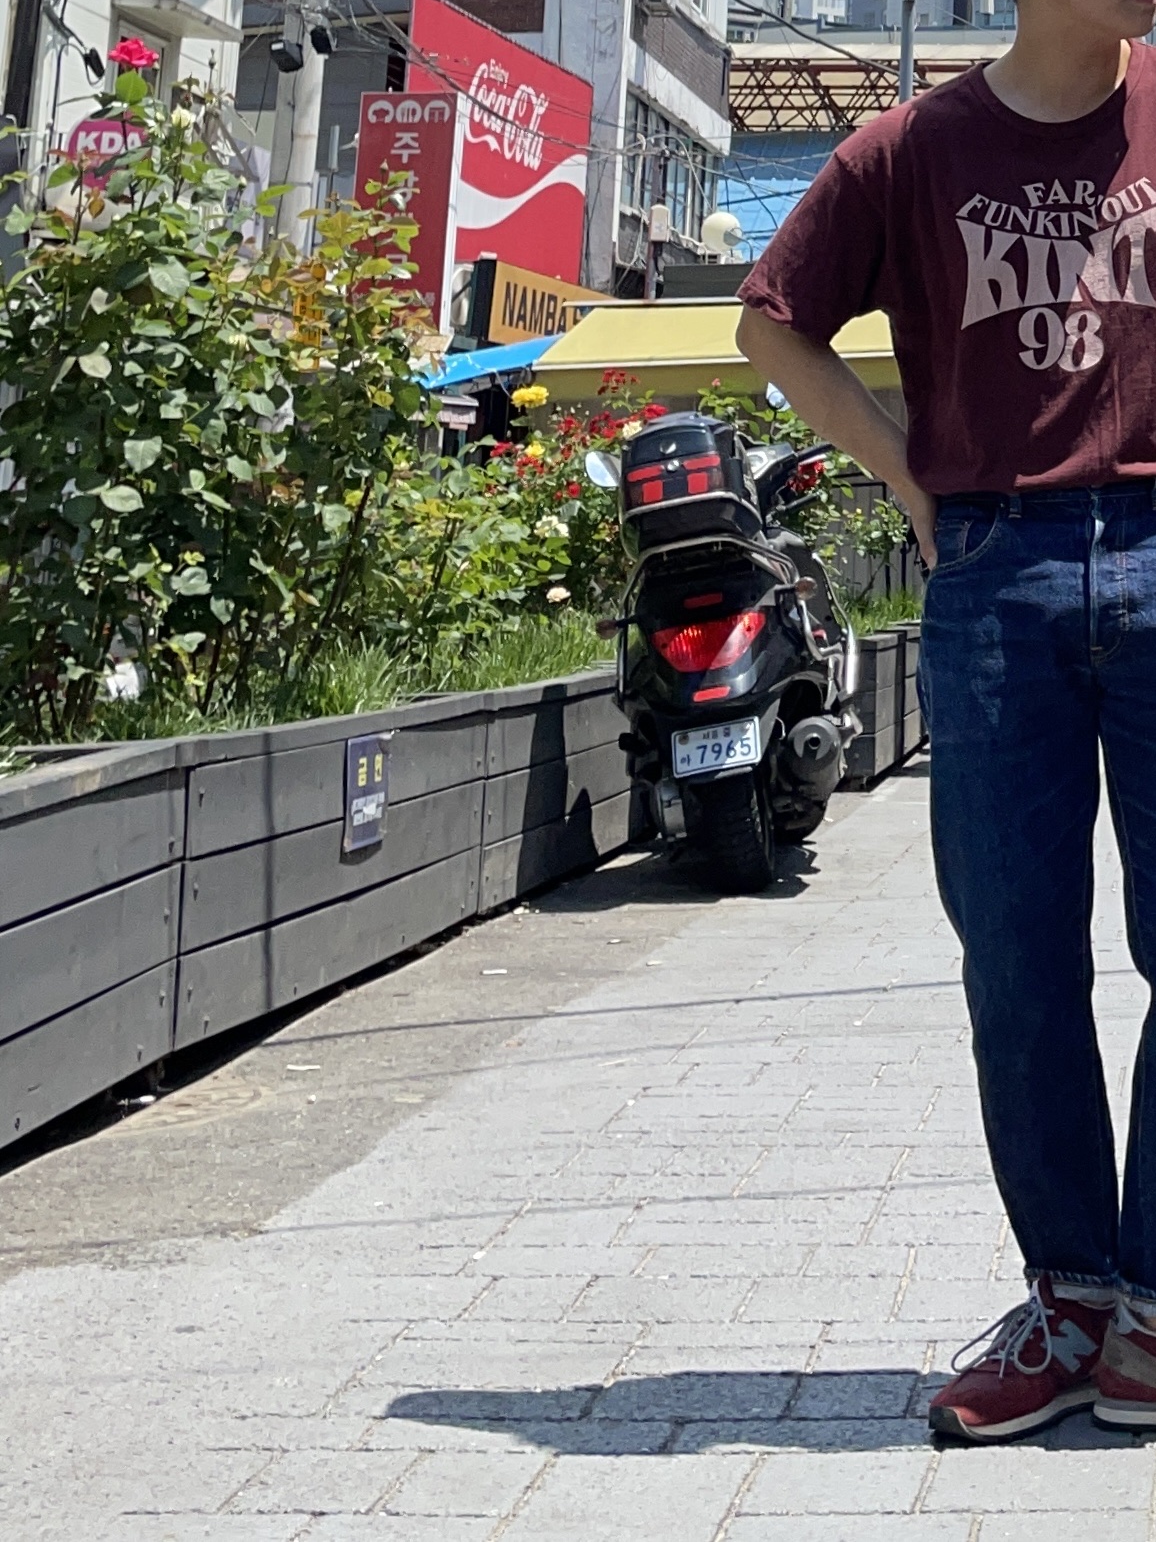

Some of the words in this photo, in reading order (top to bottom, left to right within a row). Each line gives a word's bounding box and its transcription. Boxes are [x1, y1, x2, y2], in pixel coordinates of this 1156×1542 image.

[1021, 178, 1097, 207] FAR
[1018, 307, 1105, 373] 98
[695, 736, 752, 765] 7965
